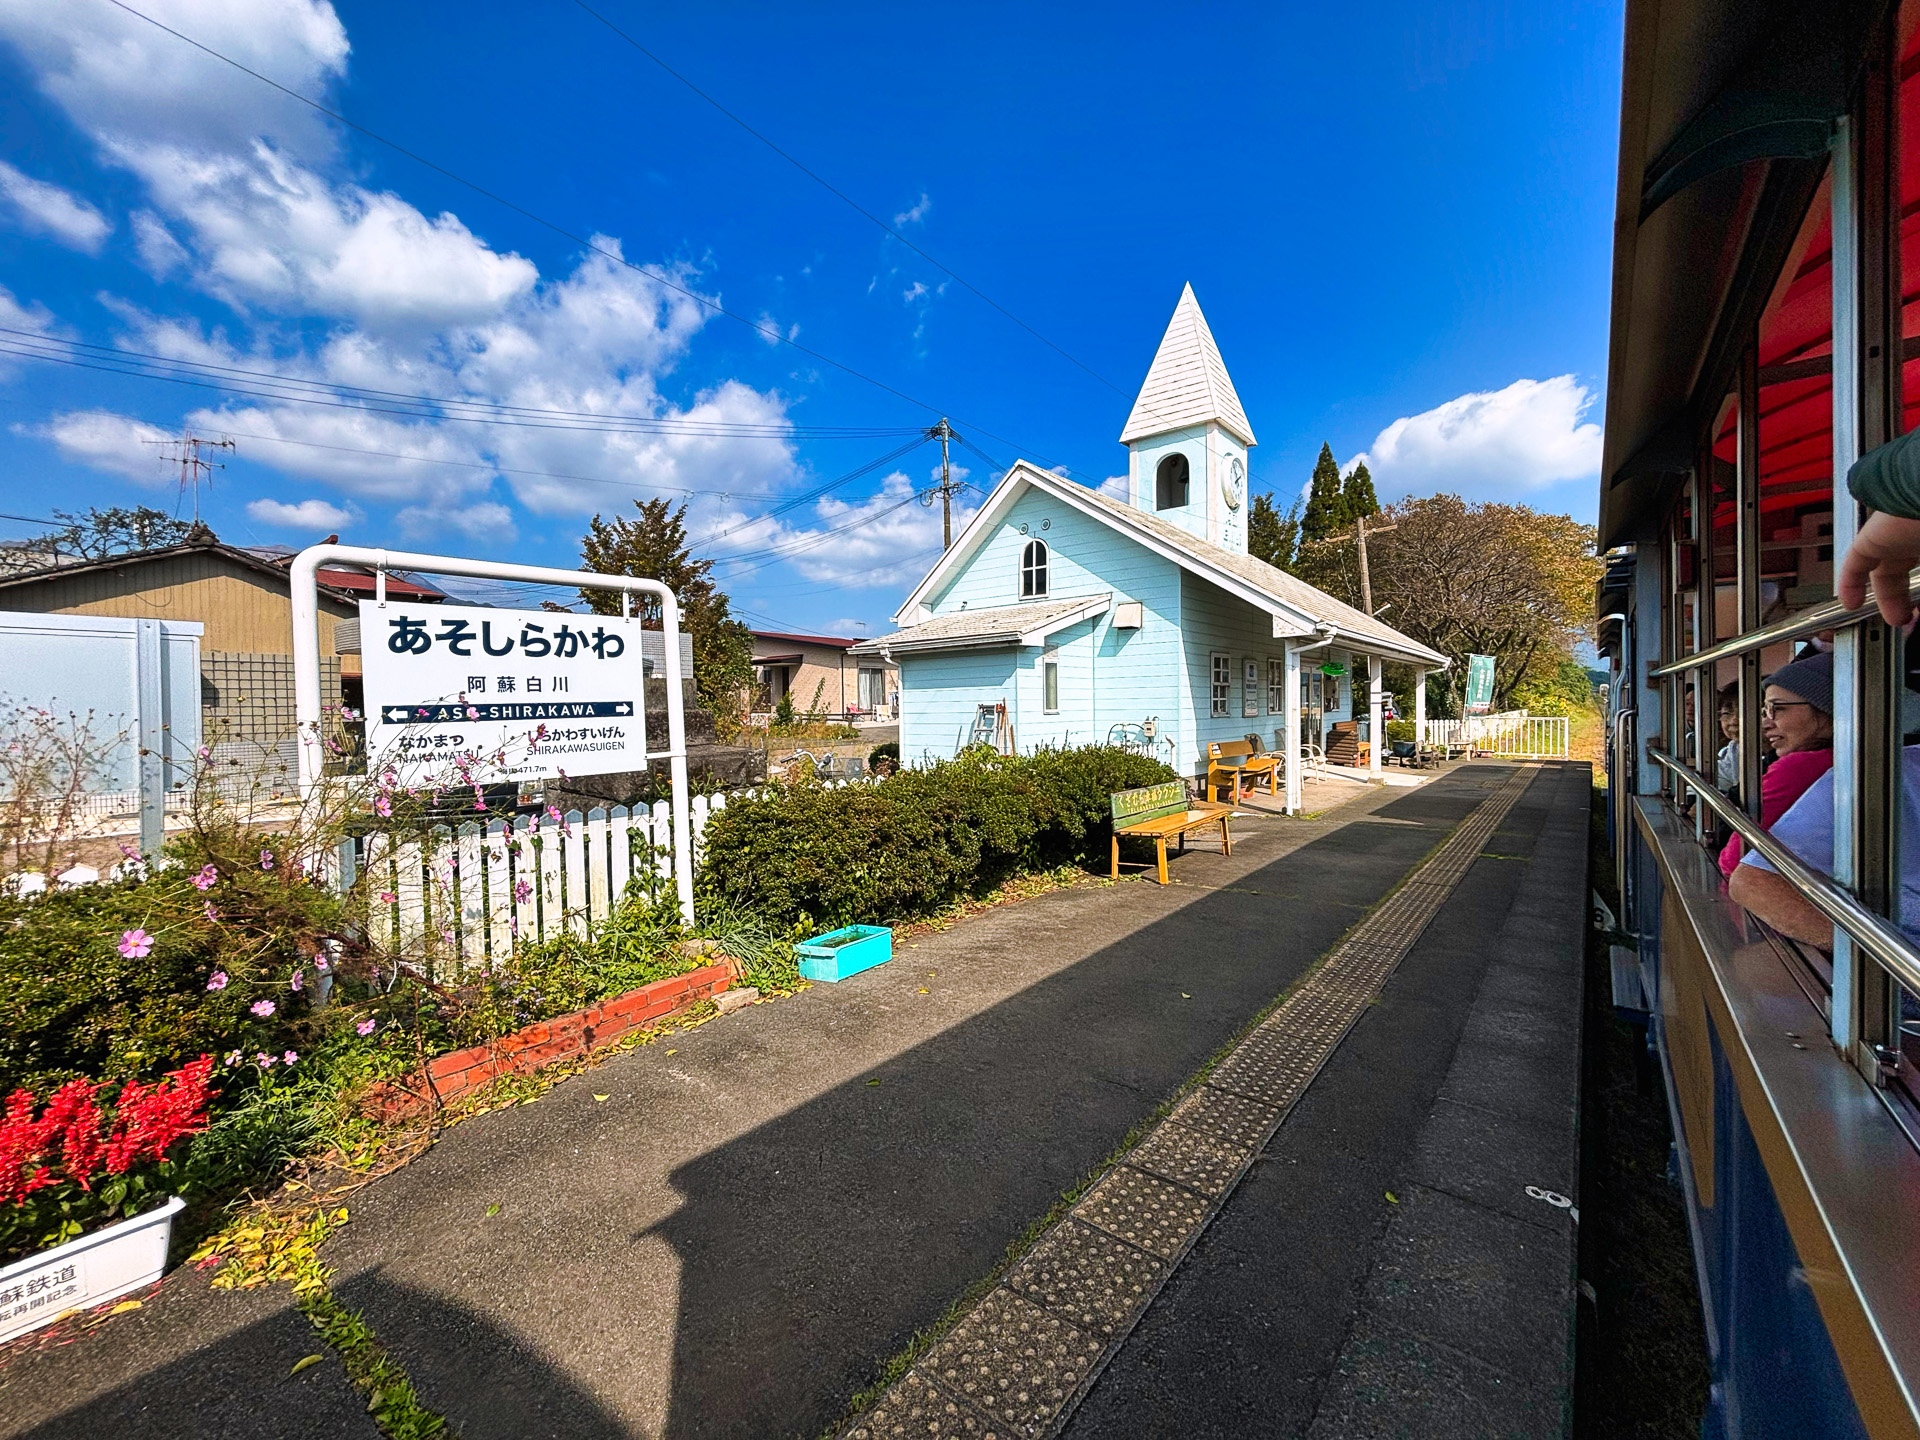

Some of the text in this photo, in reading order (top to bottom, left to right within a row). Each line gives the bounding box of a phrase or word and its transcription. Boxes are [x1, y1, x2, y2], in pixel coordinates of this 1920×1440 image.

[388, 615, 625, 660] あそしらかわ
[467, 675, 569, 693] 阿蘇白川
[437, 704, 595, 720] AS-SHIRAKAWA
[399, 733, 465, 749] なかまつ
[526, 741, 625, 756] SHIRAKAWASUIGEN
